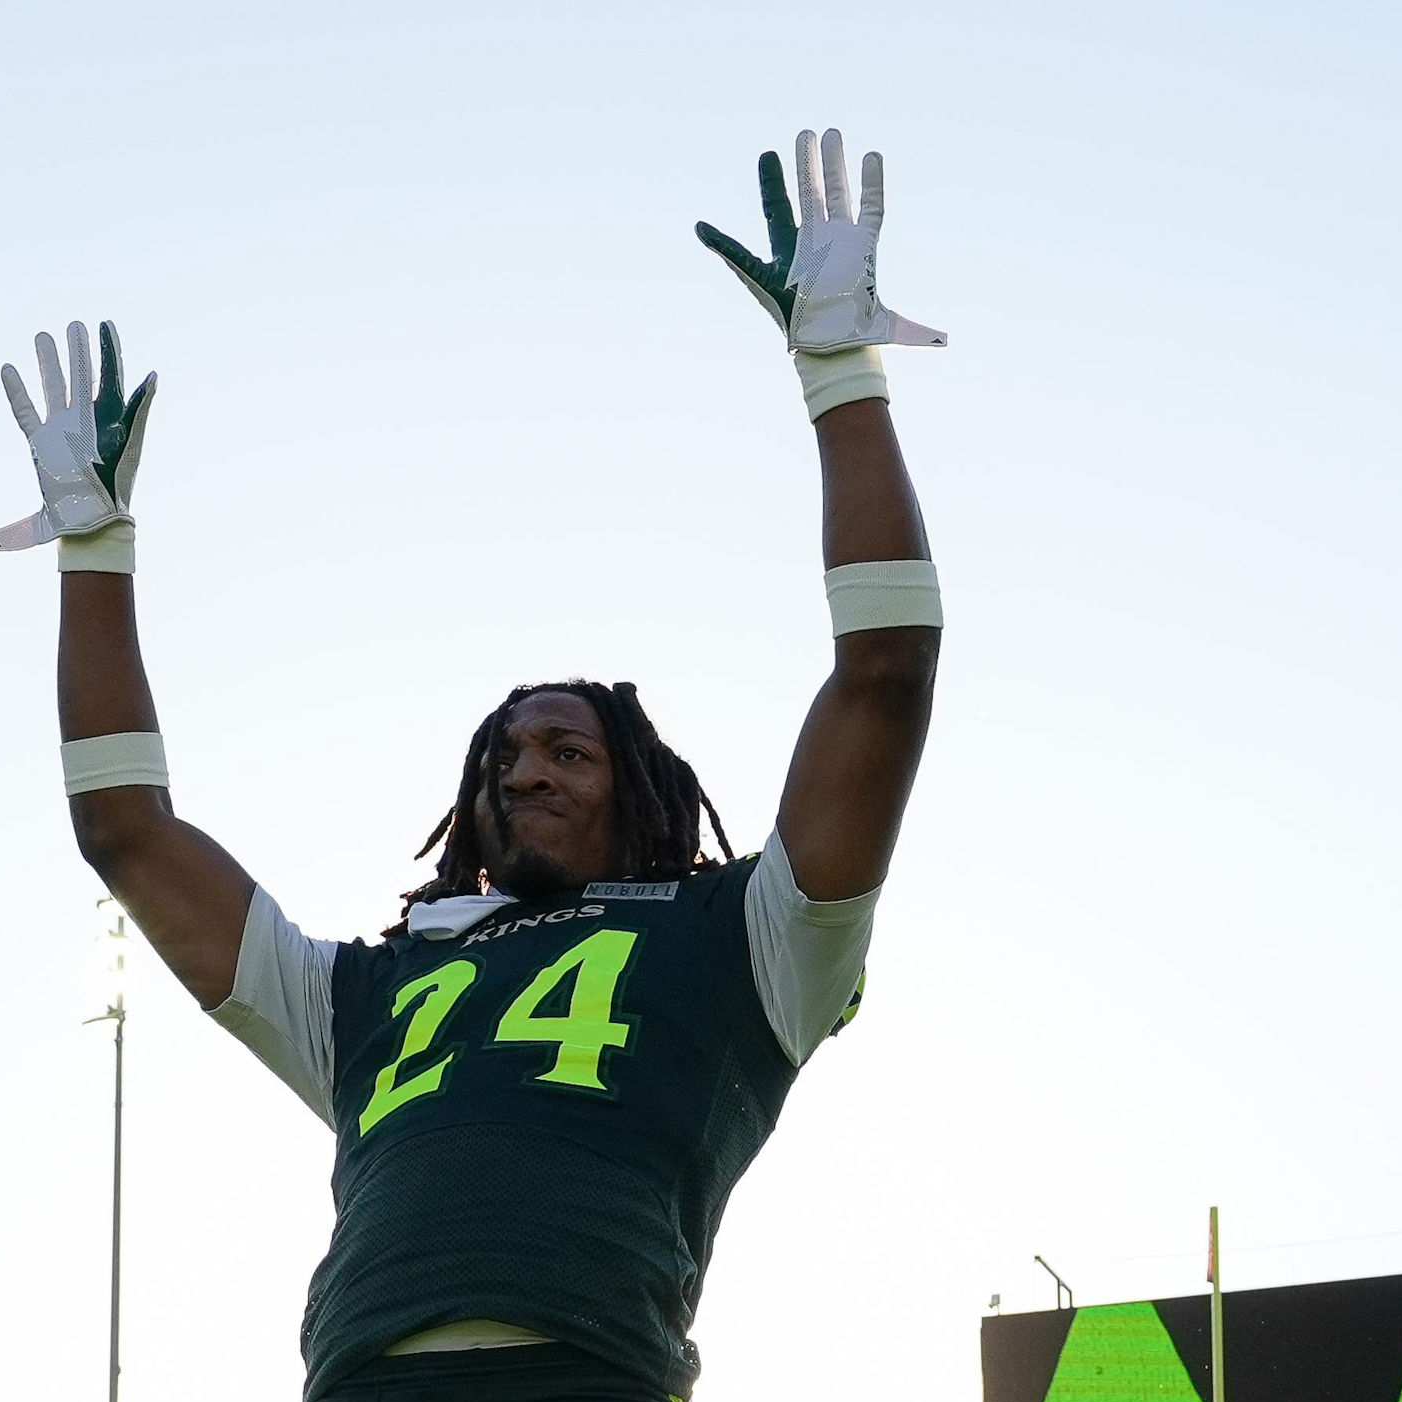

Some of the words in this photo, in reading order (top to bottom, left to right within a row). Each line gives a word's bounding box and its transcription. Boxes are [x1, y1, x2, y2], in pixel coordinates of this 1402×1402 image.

[585, 883, 676, 899] NOBULL
[460, 904, 606, 949] KINGS
[359, 929, 638, 1138] 24
